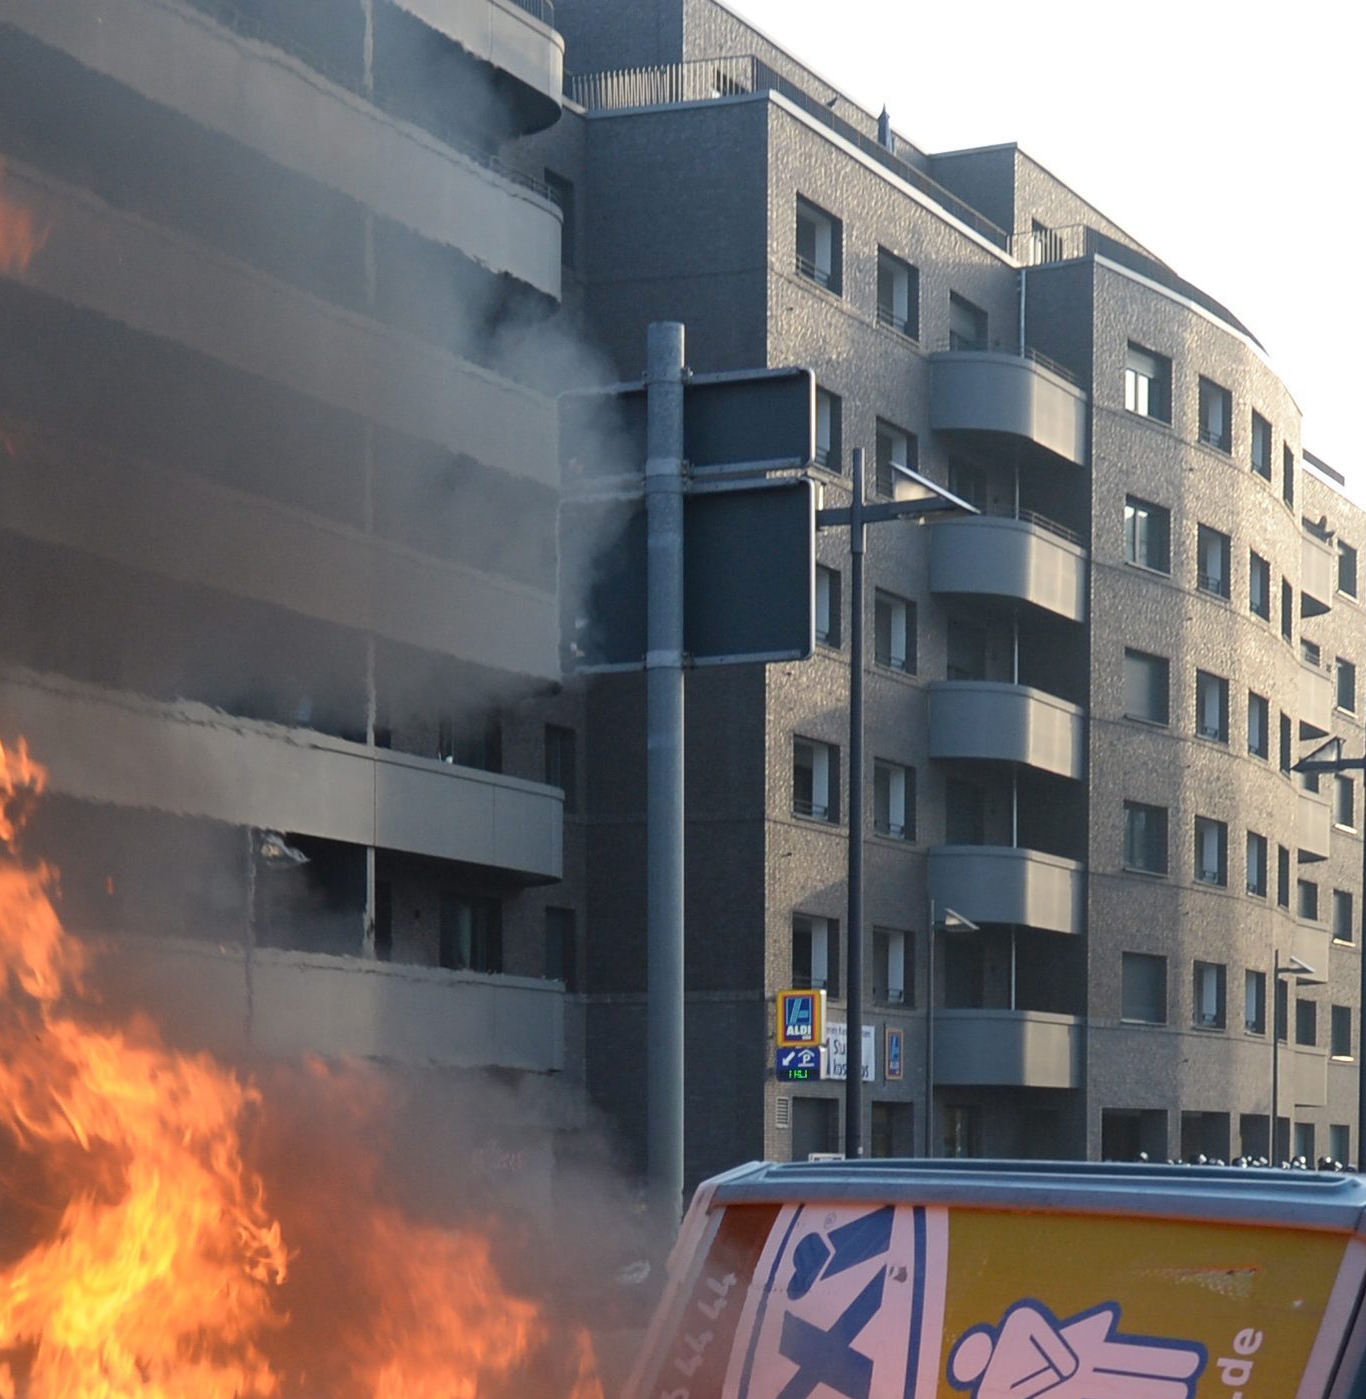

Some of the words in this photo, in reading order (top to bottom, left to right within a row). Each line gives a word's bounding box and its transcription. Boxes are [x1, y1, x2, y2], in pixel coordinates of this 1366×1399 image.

[786, 1025, 812, 1036] ALDI
[673, 1329, 715, 1378] 44
[697, 1272, 738, 1320] 44
